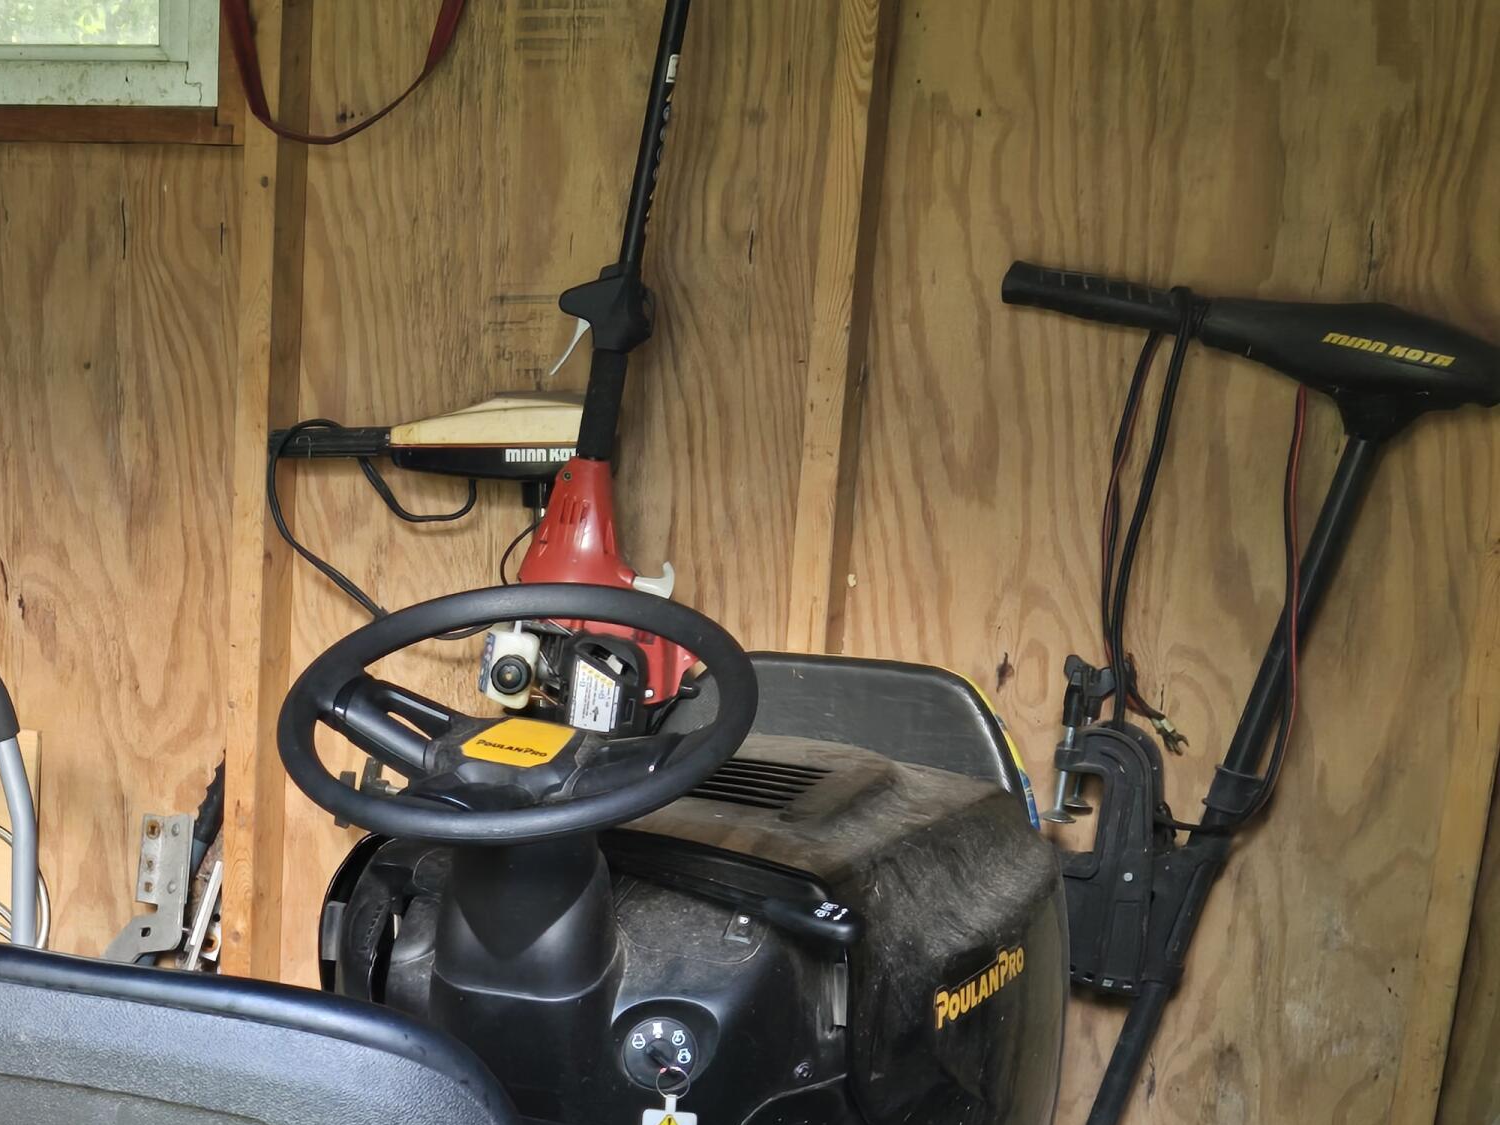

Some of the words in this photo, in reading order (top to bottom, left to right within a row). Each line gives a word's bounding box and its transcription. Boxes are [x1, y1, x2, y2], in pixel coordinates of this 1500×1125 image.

[1322, 332, 1388, 353] MINN
[1387, 344, 1456, 367] KOTA
[504, 448, 547, 463] MINN
